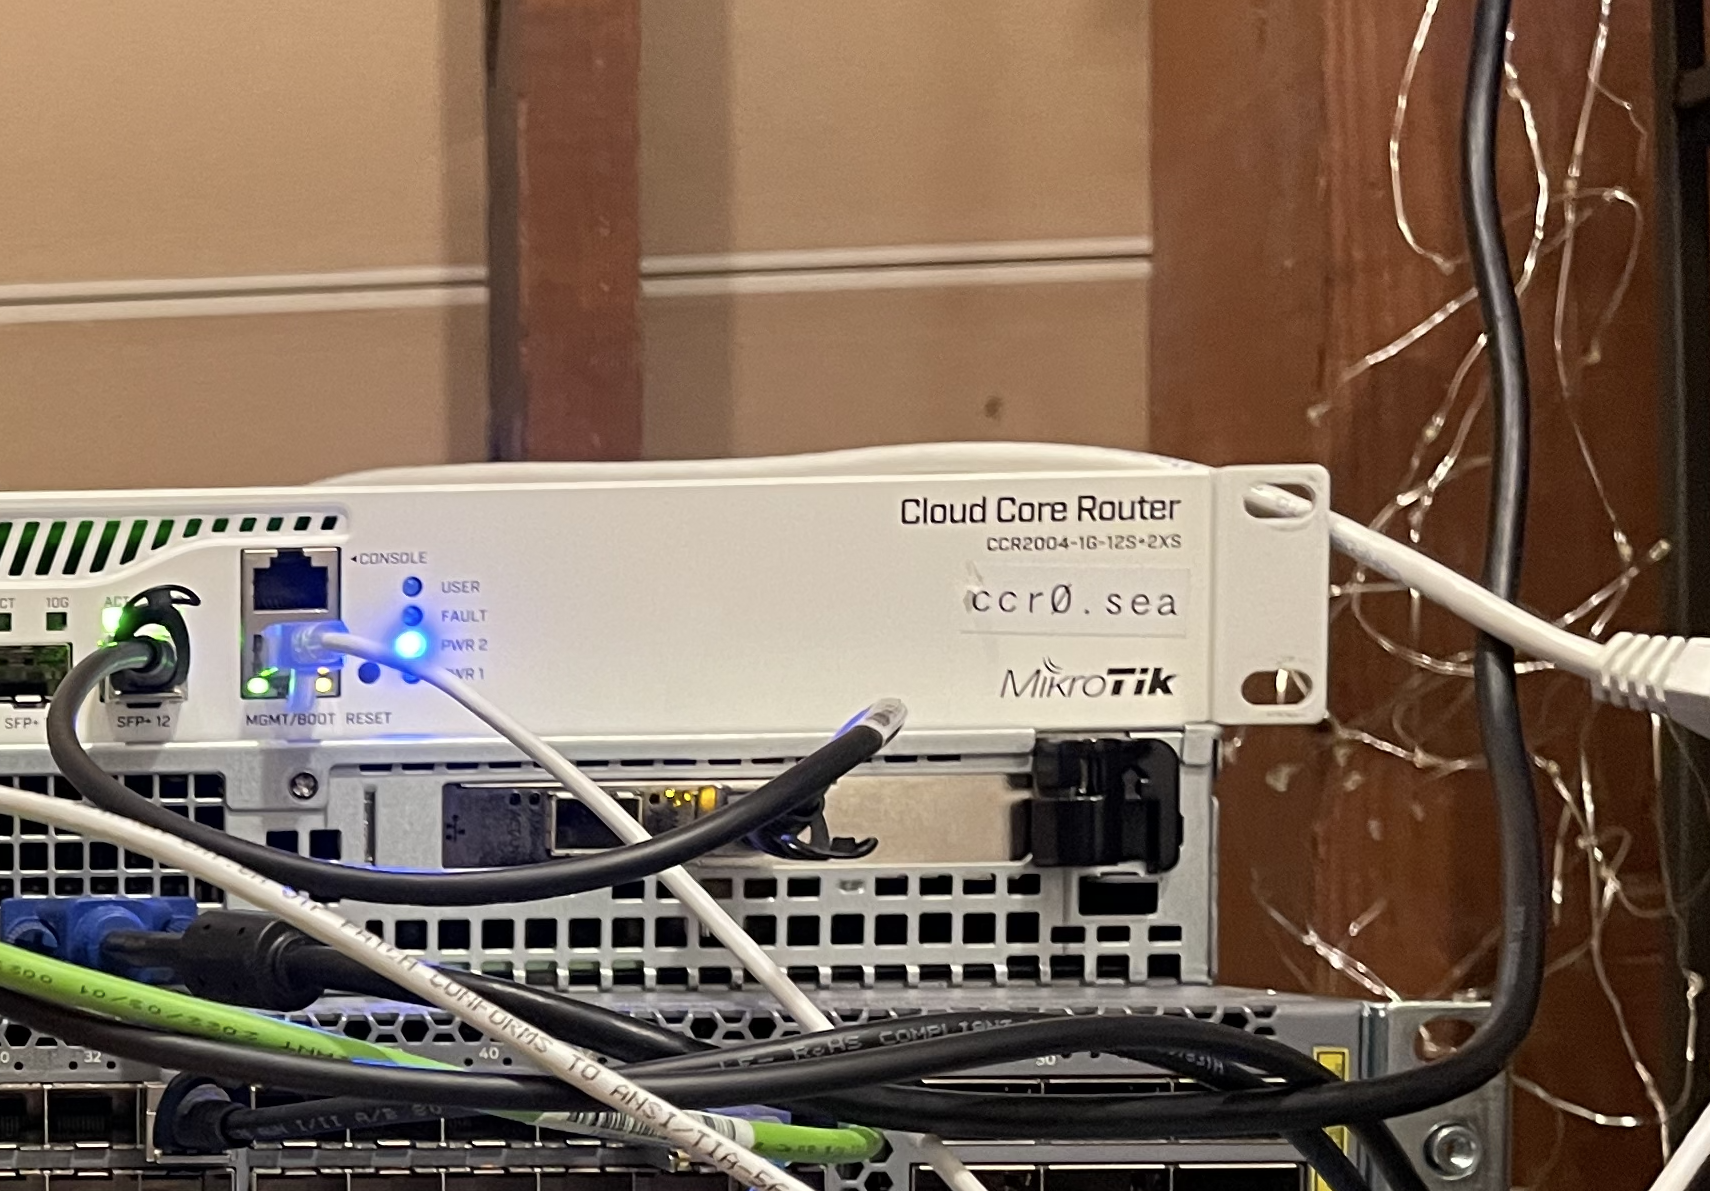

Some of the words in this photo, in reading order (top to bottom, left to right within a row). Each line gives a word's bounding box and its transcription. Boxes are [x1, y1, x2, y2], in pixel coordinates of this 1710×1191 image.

[901, 497, 986, 525] Cloud
[996, 497, 1067, 523] Core
[1077, 495, 1182, 522] Router
[359, 552, 428, 565] CONSOLE
[441, 581, 481, 594] USER
[46, 597, 69, 609] 10G
[441, 610, 487, 622] FAULT
[441, 639, 475, 652] PWR
[476, 638, 488, 651] 2
[478, 668, 485, 680] 1
[1000, 660, 1177, 698] MikroTik
[4, 718, 39, 729] SFP+
[117, 716, 152, 728] SFP+
[156, 715, 171, 728] 12
[245, 713, 336, 726] MGMT/BOOT
[345, 712, 393, 725] RESET
[83, 1051, 103, 1063] 32
[478, 1047, 500, 1060] 40
[569, 1053, 602, 1081] TO
